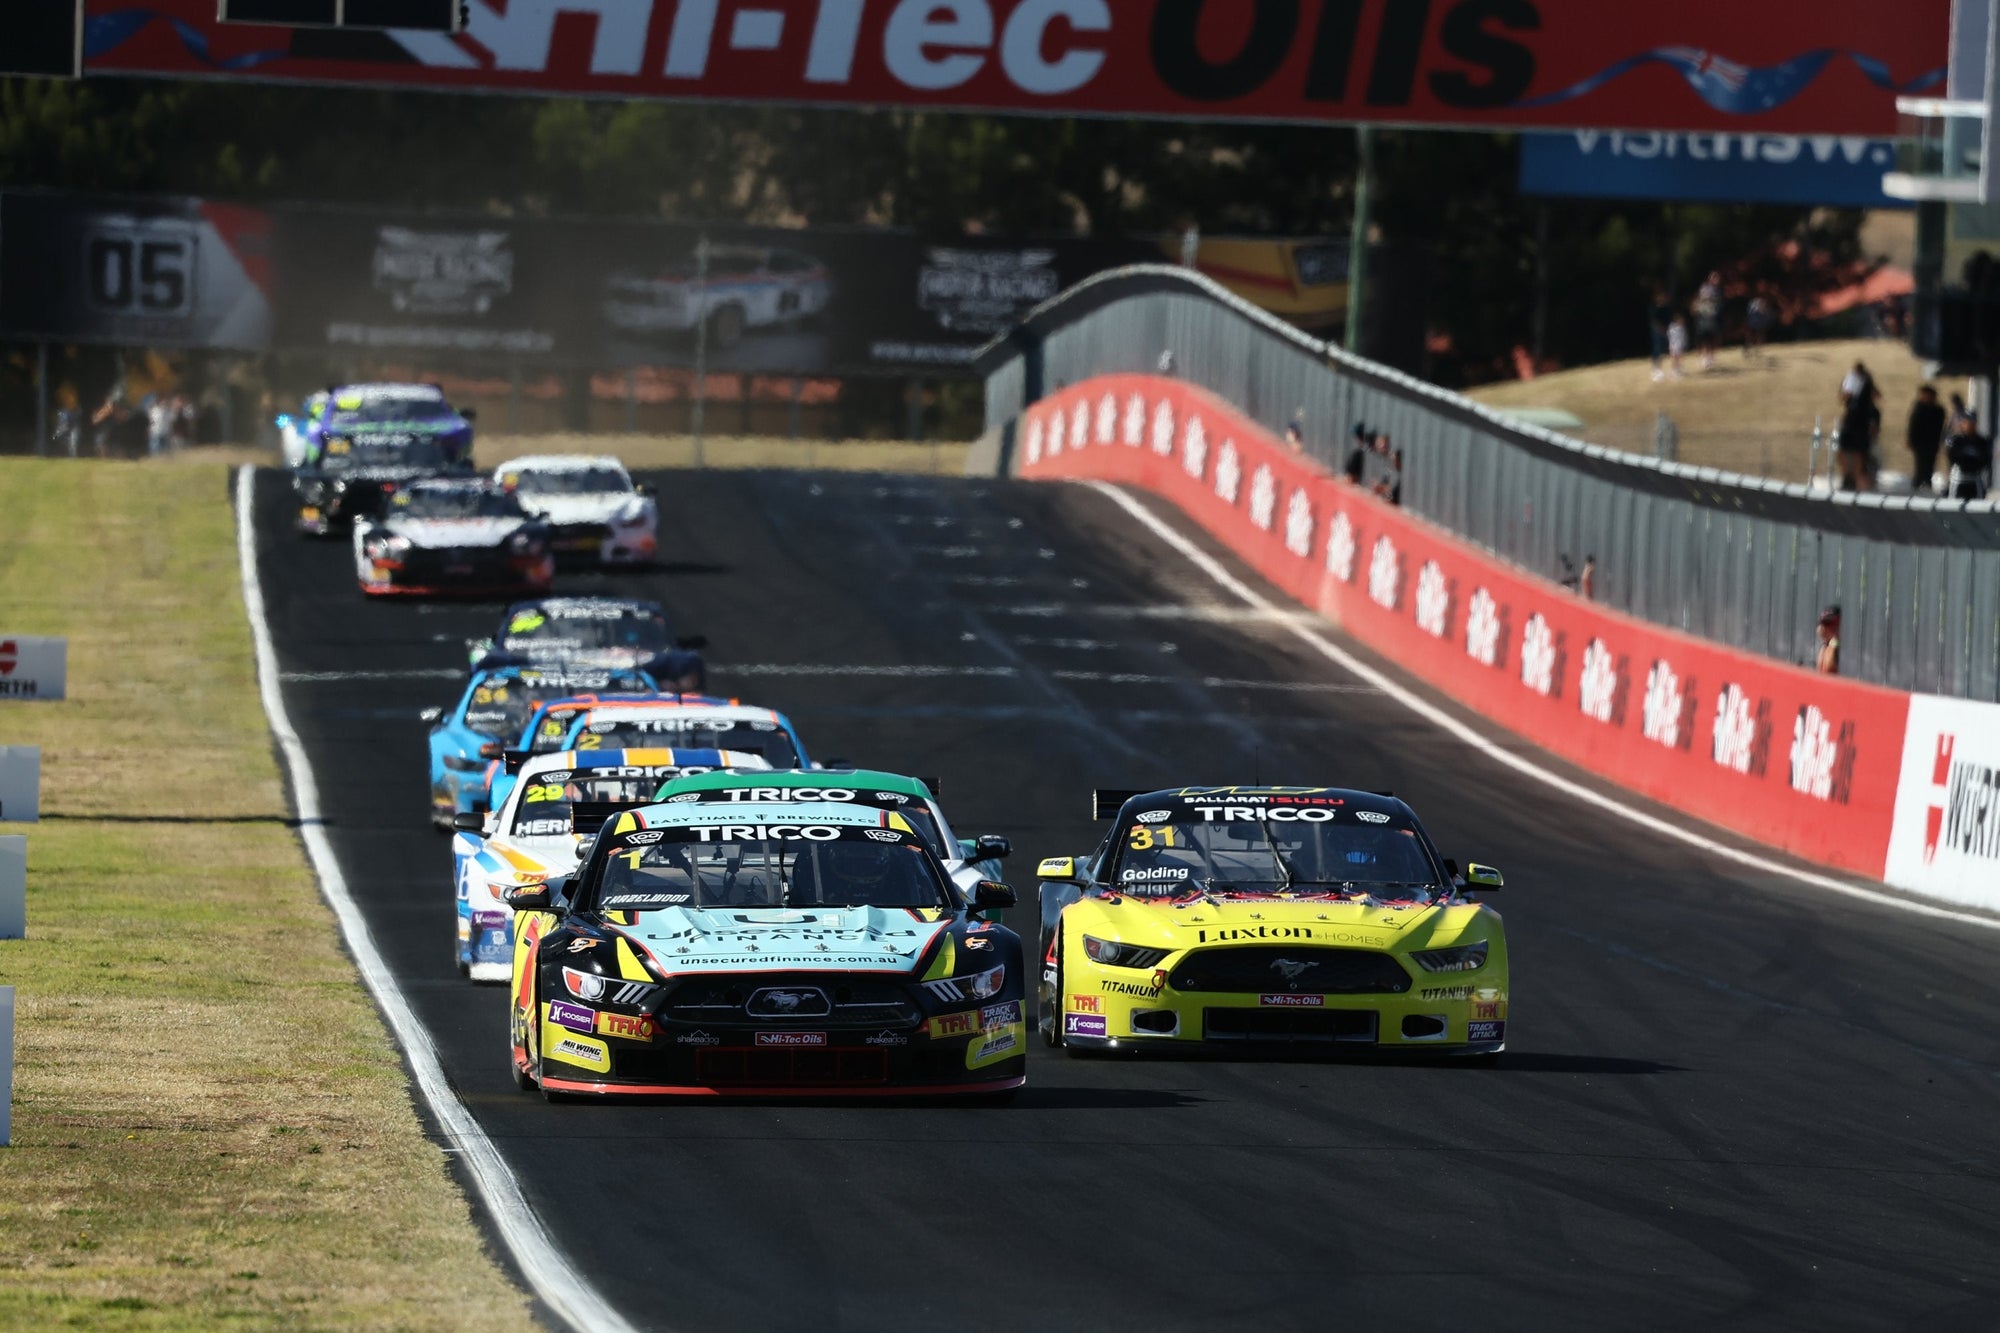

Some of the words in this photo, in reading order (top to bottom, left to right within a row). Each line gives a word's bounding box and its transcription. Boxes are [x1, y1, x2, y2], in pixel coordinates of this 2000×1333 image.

[91, 237, 185, 309] 05
[544, 721, 562, 738] 5
[527, 785, 565, 803] 29
[722, 787, 856, 802] TRICO
[651, 816, 690, 825] EASY
[696, 814, 746, 822] TIMES
[777, 814, 853, 822] BREWING
[1194, 807, 1335, 822] TRICO
[689, 825, 841, 842] TRICO
[1130, 825, 1175, 850] 31
[619, 851, 641, 870] 1
[1122, 867, 1189, 882] Golding
[609, 894, 691, 905] HAZELWOOD
[1199, 926, 1313, 944] Luxton
[1325, 932, 1386, 947] HOMES
[680, 956, 898, 965] unsecuredfinance.com.au
[1101, 980, 1160, 998] TITANIUM
[1420, 985, 1476, 999] TITANIUM
[1073, 995, 1097, 1012] TFH
[1272, 995, 1300, 1005] Hi-Tec
[1302, 995, 1321, 1006] Oils
[561, 1011, 592, 1025] HOOSIER
[983, 1004, 1011, 1018] TRACK
[988, 1012, 1016, 1025] ATTACK
[607, 1014, 642, 1036] TFH
[937, 1014, 970, 1034] TFH
[1078, 1020, 1105, 1030] HOOSIER
[1469, 1022, 1495, 1032] TRACK
[770, 1034, 801, 1044] Hi-Tec
[802, 1034, 823, 1045] Oils
[1471, 1030, 1499, 1039] ATTACK
[576, 1042, 602, 1057] WONG
